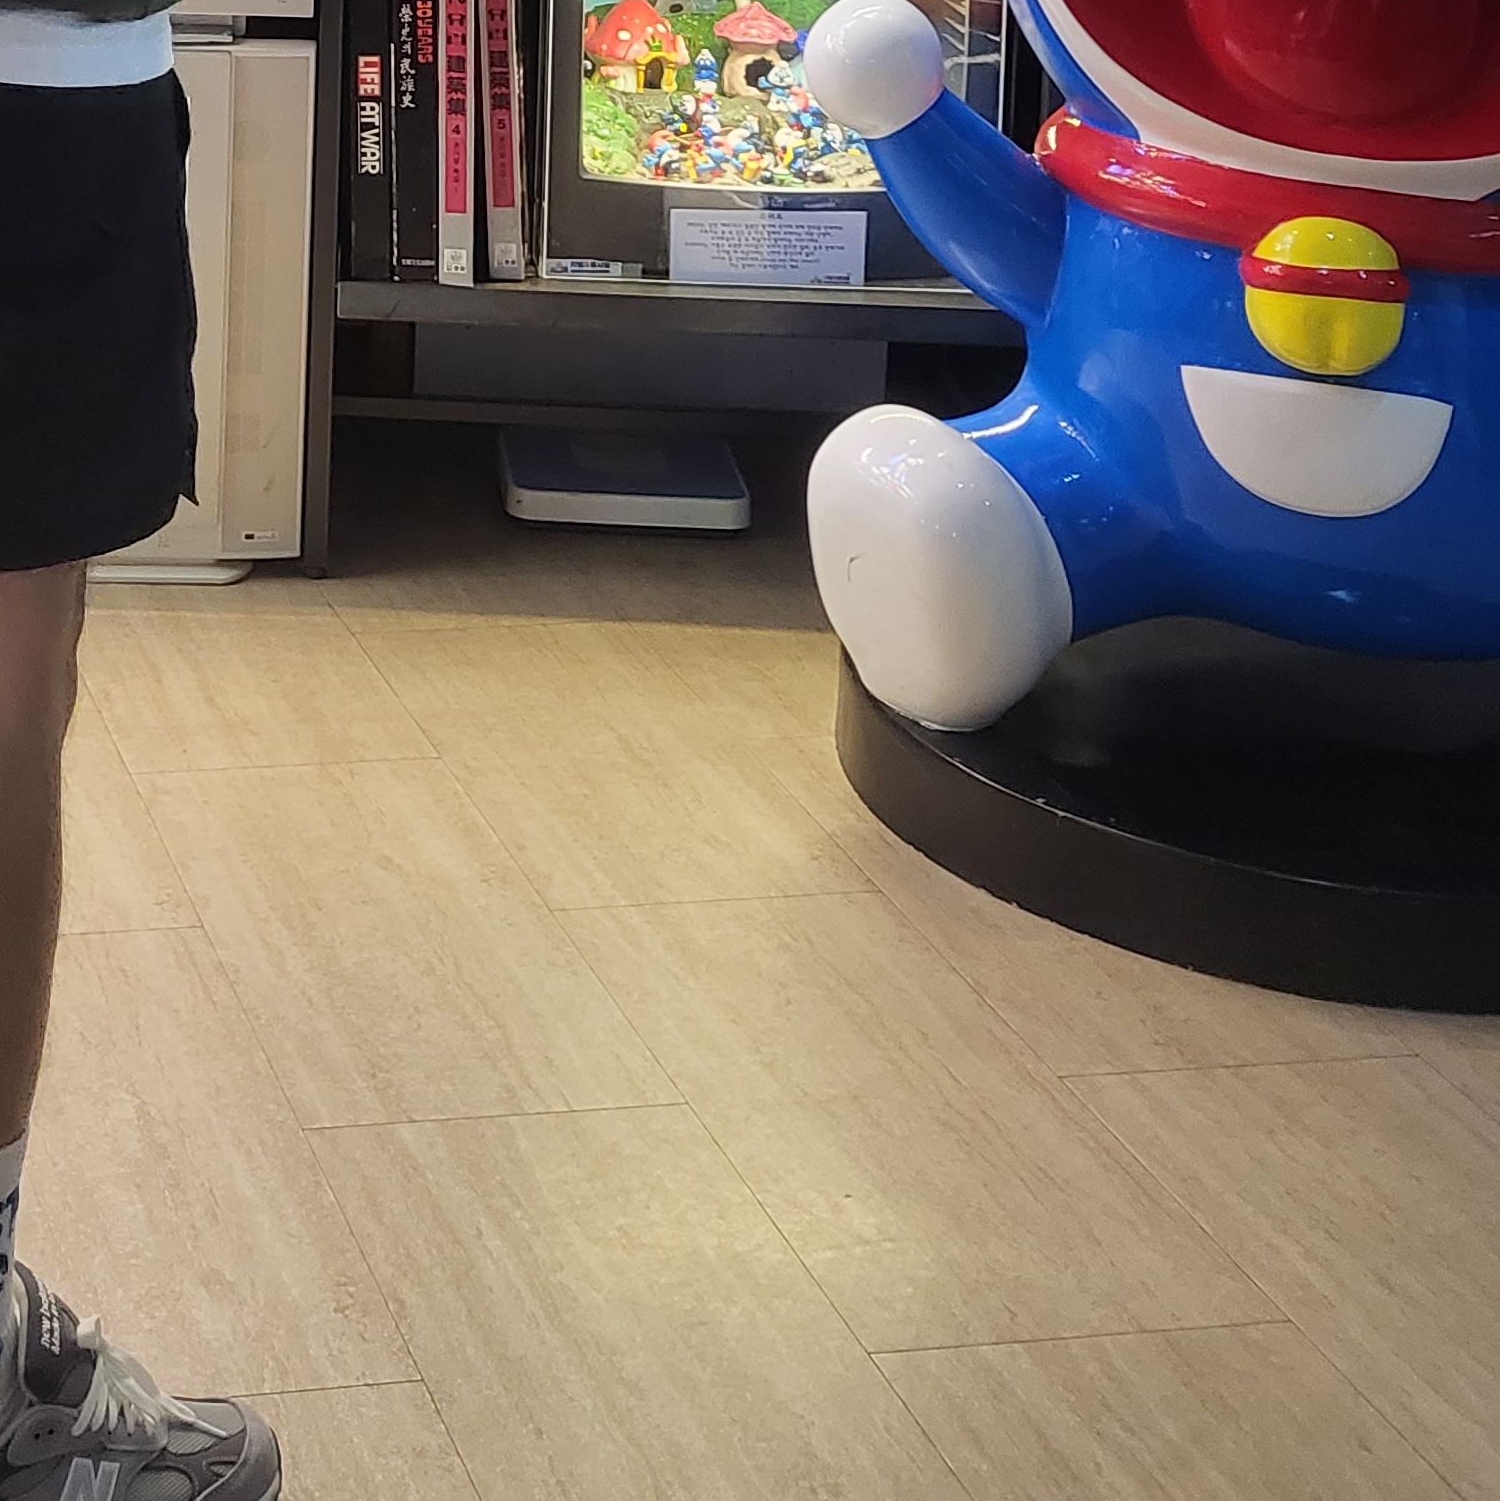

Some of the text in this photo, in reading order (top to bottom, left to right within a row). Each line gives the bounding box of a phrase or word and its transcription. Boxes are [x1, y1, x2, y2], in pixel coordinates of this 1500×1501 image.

[358, 56, 381, 175] LIFE AT WAR
[451, 124, 461, 136] 4
[497, 118, 506, 130] 5
